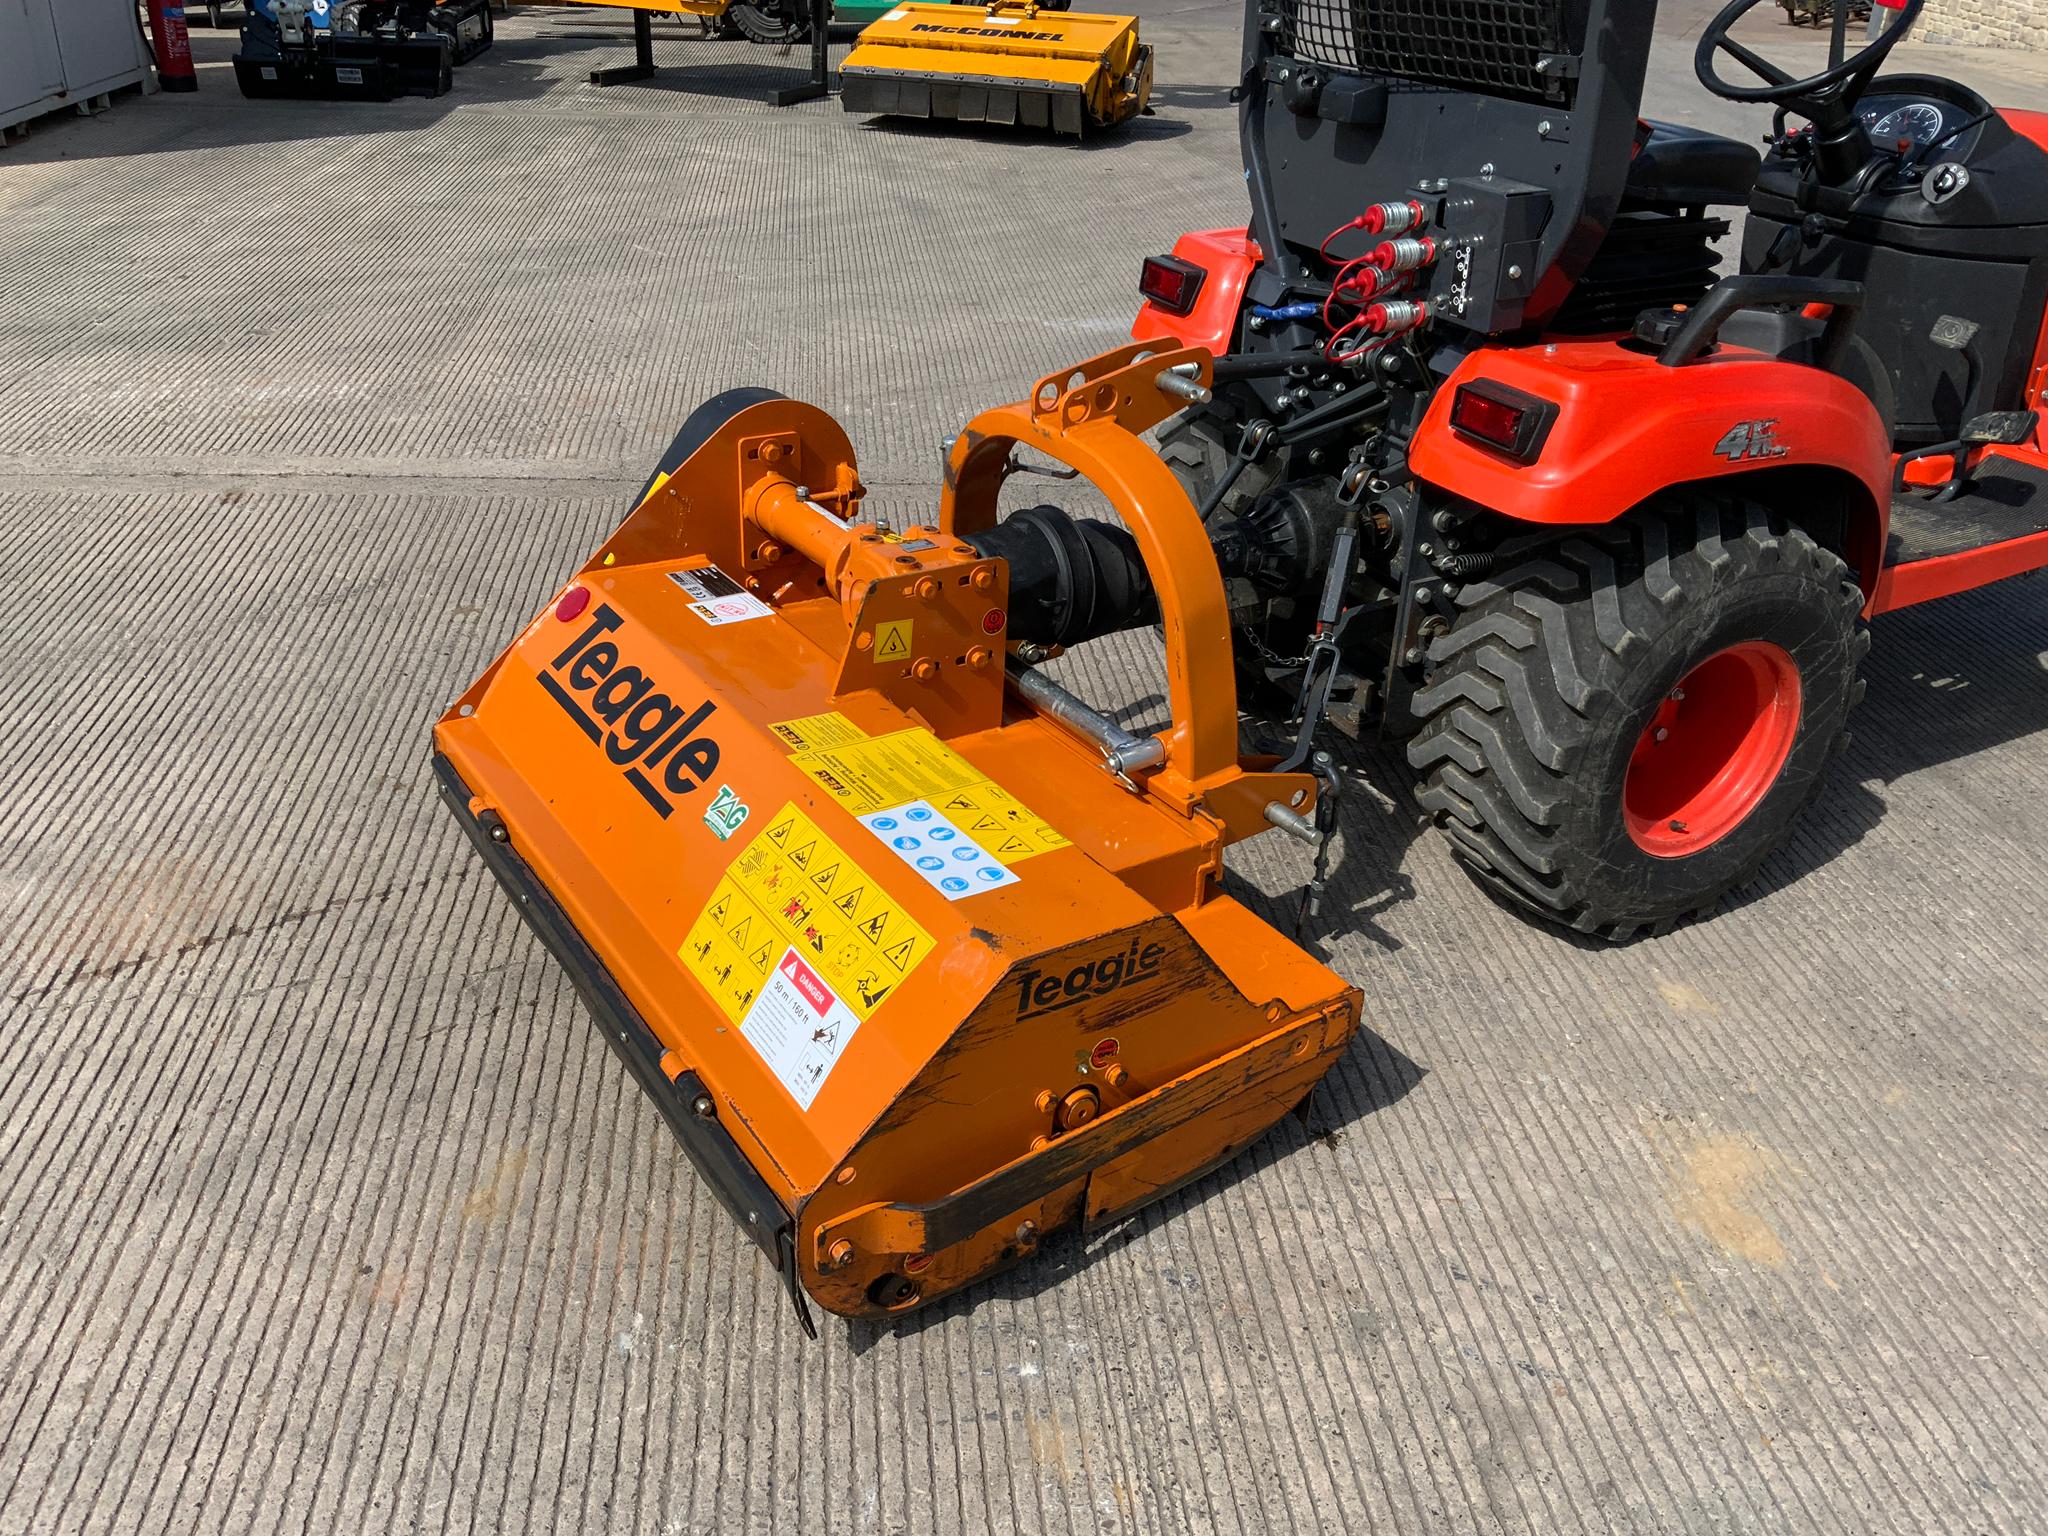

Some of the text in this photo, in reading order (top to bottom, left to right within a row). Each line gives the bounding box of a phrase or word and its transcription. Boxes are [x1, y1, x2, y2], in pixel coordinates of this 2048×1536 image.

[550, 602, 721, 795] Teagle
[710, 786, 747, 830] TAG
[799, 974, 825, 1005] DANGER
[826, 961, 844, 978] STOP
[774, 981, 784, 993] 50
[781, 992, 789, 1001] m
[791, 1001, 804, 1017] 160
[802, 1013, 809, 1024] ft
